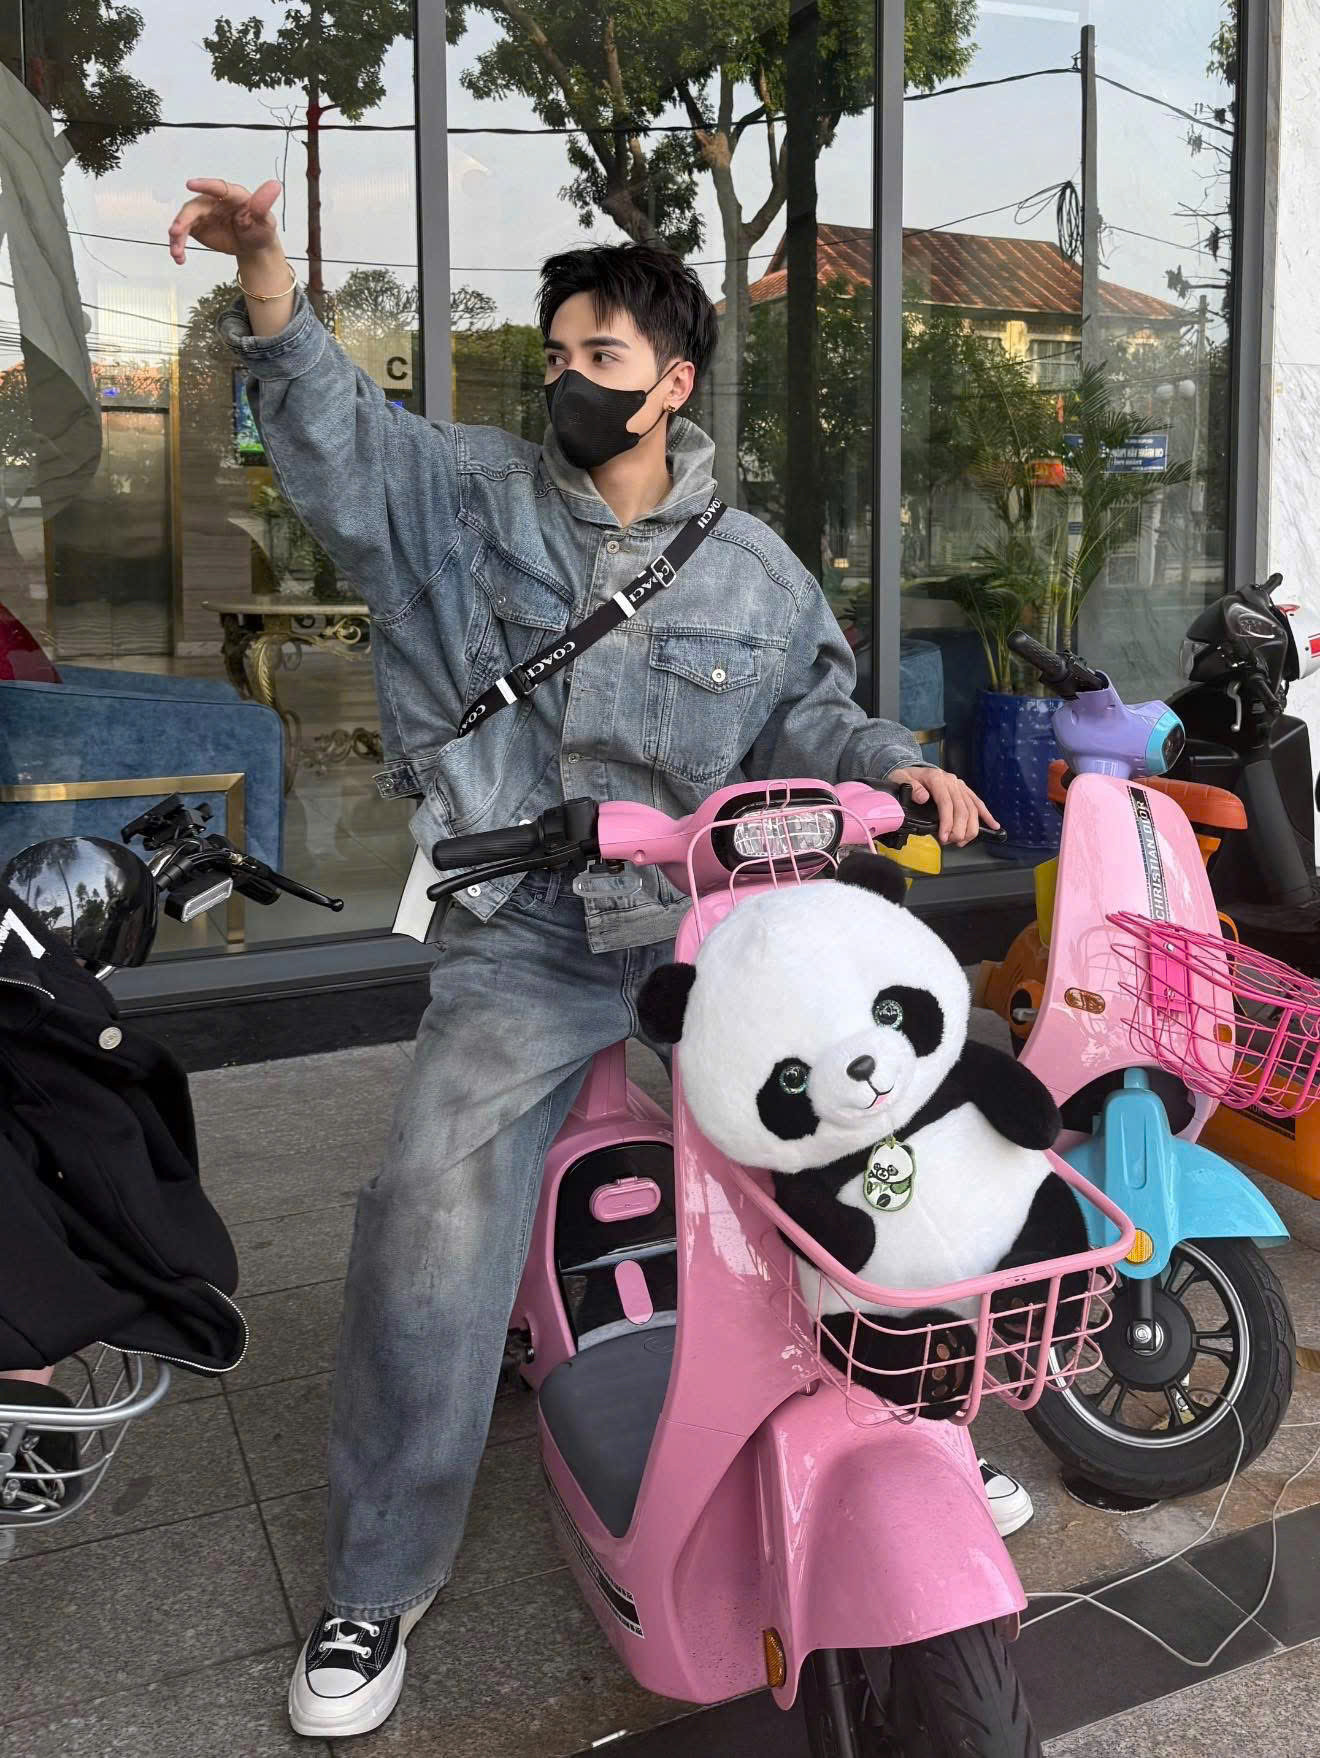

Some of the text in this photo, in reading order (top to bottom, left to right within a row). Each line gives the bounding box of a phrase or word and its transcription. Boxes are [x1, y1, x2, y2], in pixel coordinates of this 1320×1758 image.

[386, 356, 408, 381] C
[1136, 800, 1166, 920] CHRISTIAN DIOR
